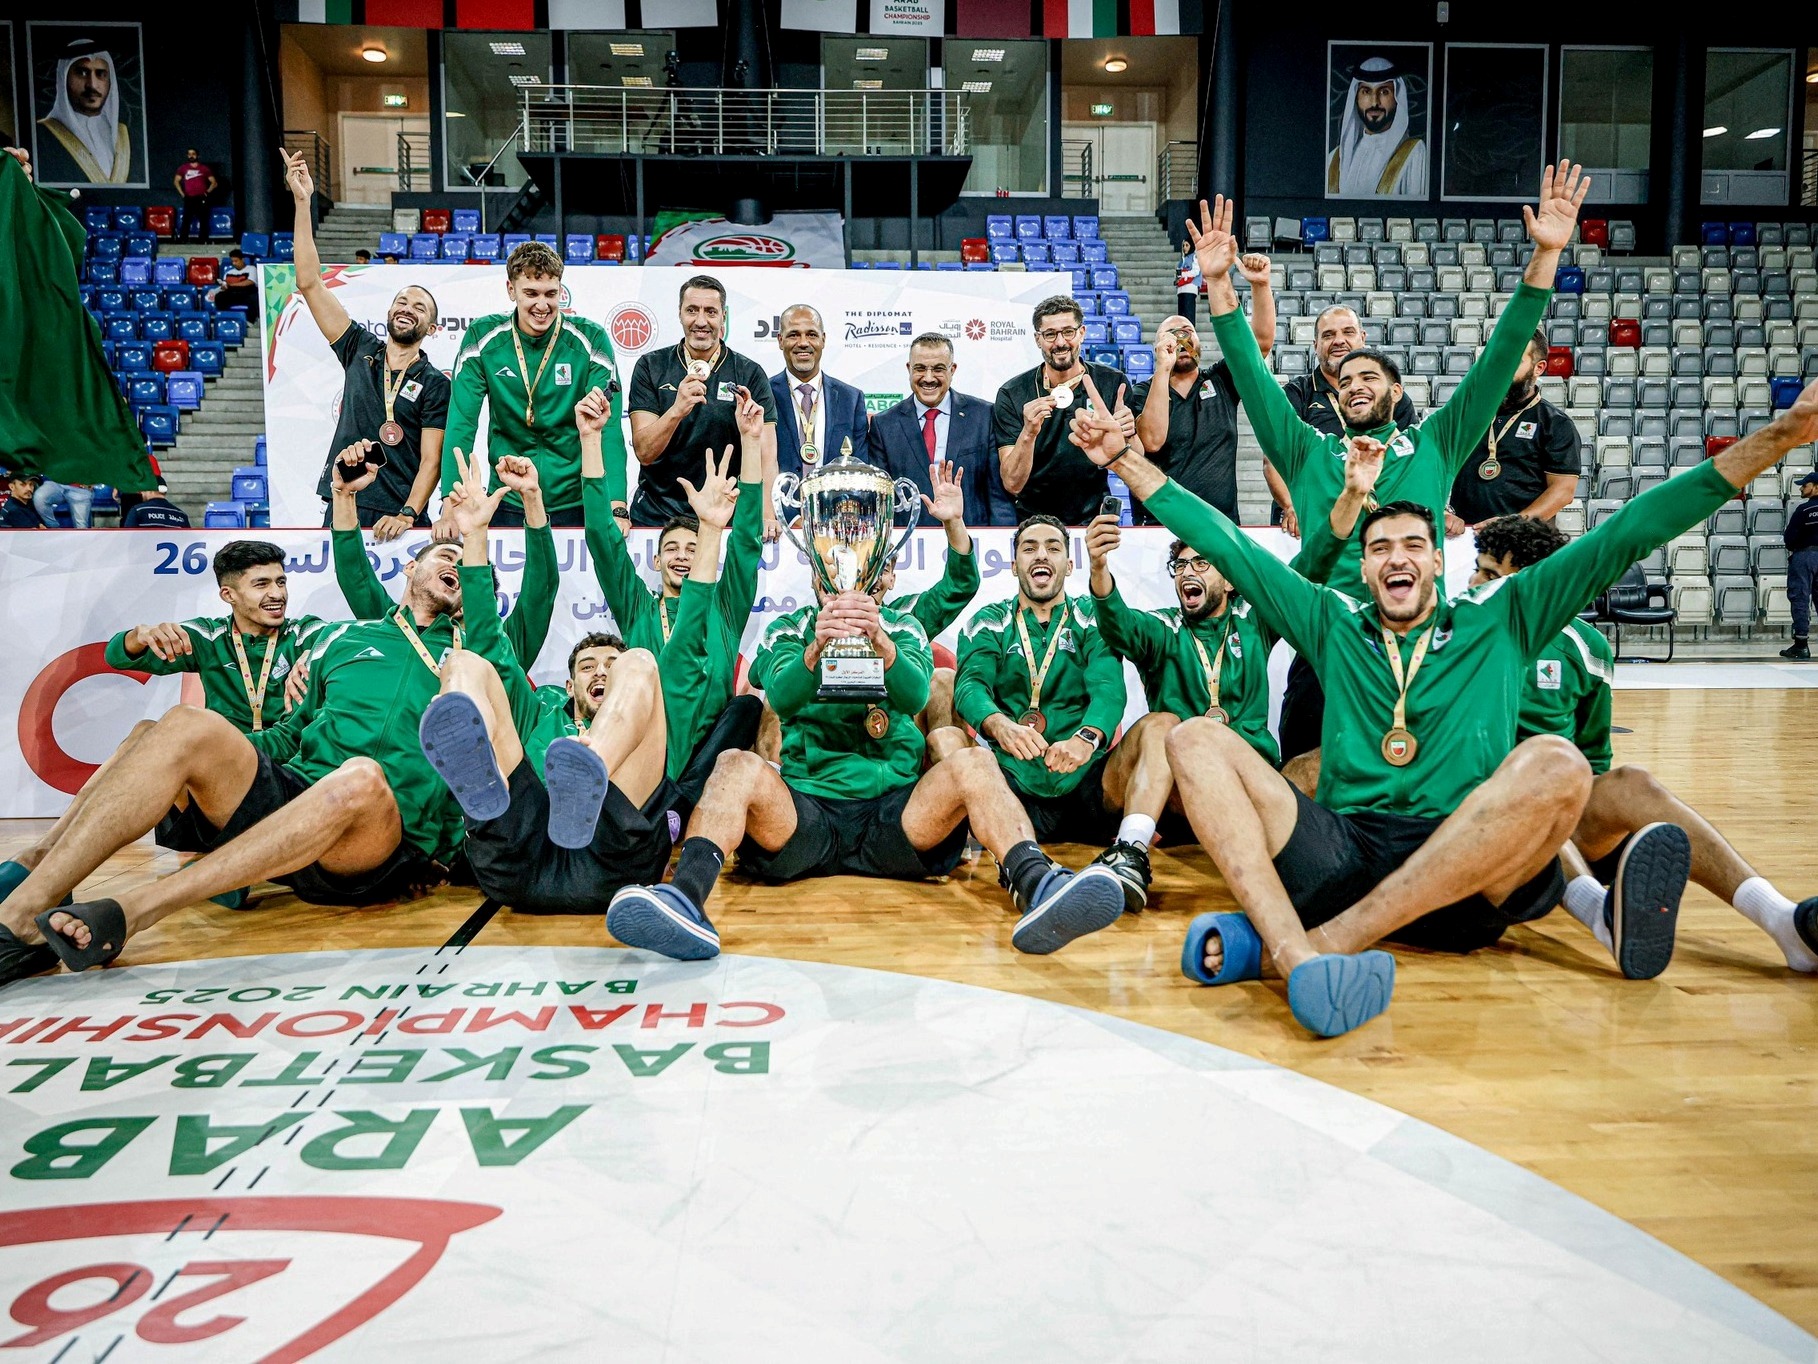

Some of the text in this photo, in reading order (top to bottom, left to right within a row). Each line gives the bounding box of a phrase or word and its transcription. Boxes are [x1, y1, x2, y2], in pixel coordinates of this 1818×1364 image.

[884, 5, 929, 13] BASKETBALL
[845, 321, 898, 340] Radisson
[990, 328, 1026, 336] BAHRAIN
[153, 541, 208, 575] 26
[139, 979, 639, 1005] BAHRAIN 2025
[10, 1104, 593, 1180] ARAB
[0, 1258, 293, 1347] 26
